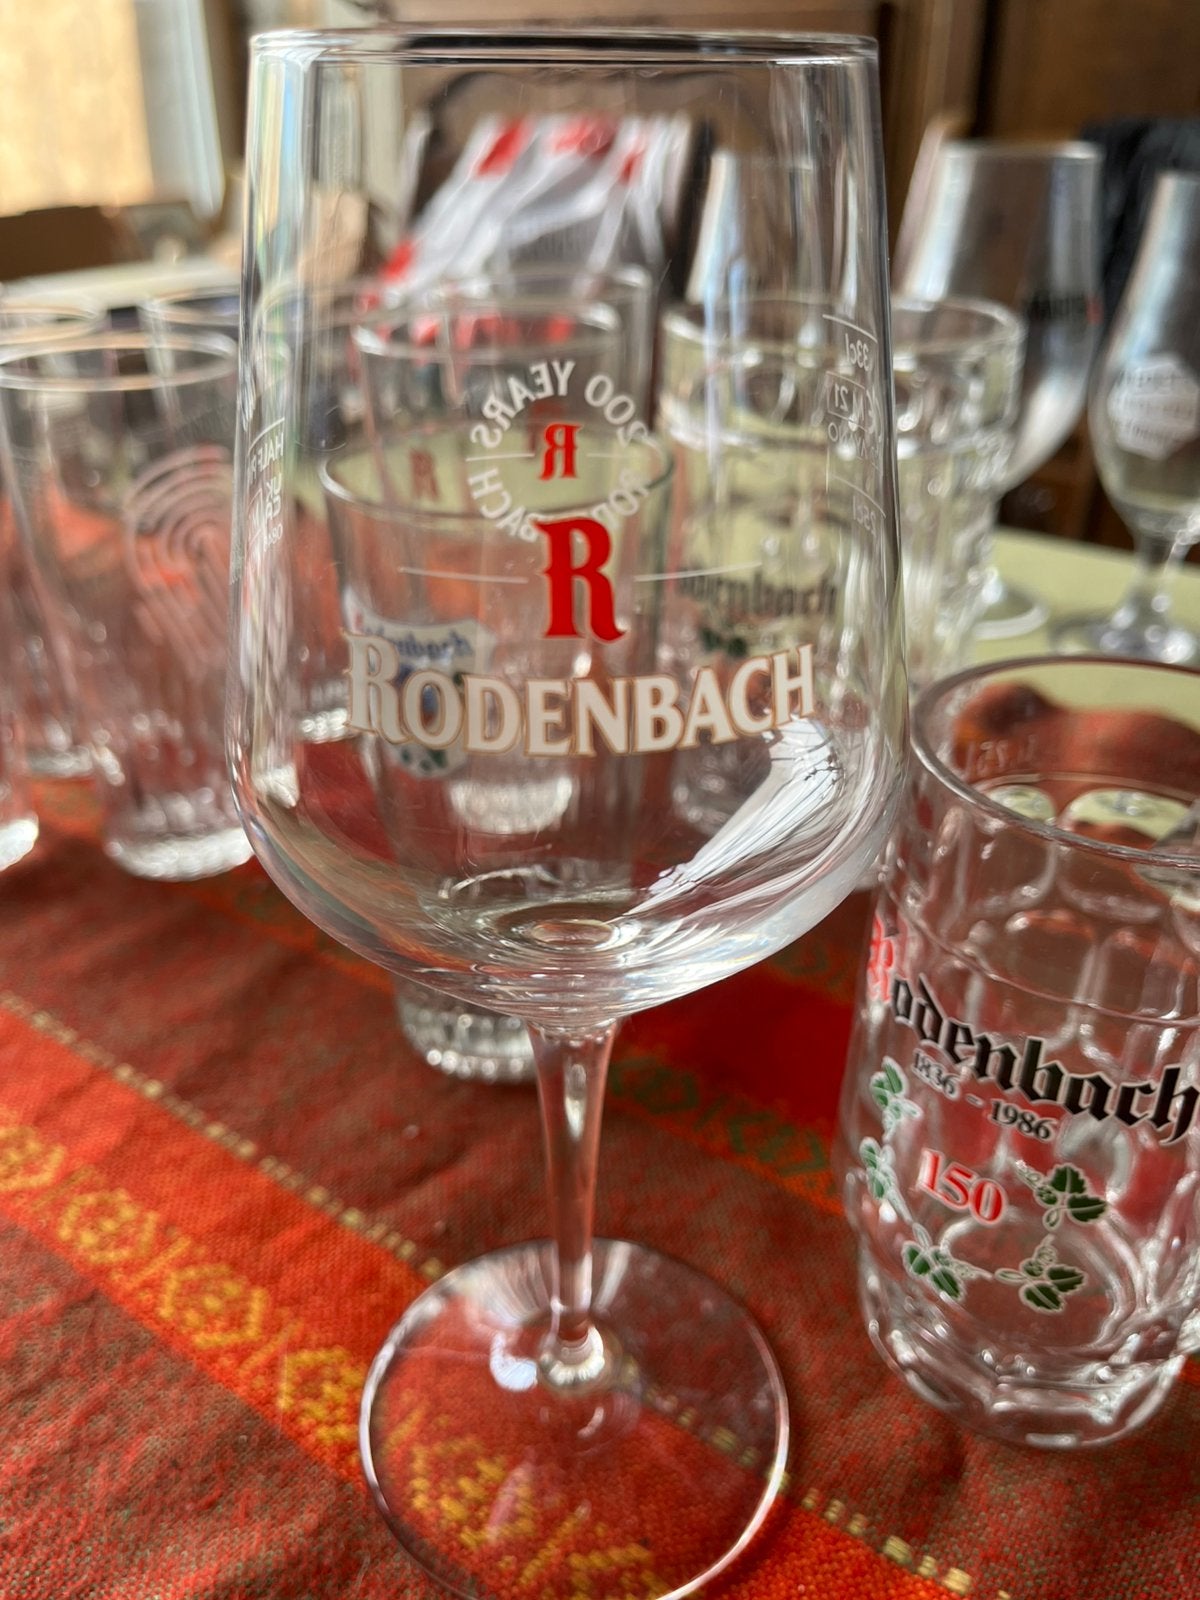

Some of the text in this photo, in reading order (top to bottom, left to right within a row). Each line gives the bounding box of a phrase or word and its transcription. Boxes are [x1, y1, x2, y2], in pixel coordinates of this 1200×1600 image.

[533, 516, 631, 645] R
[911, 1050, 960, 1098] 1836
[988, 1098, 1058, 1141] 1986
[918, 1150, 1005, 1225] 150
